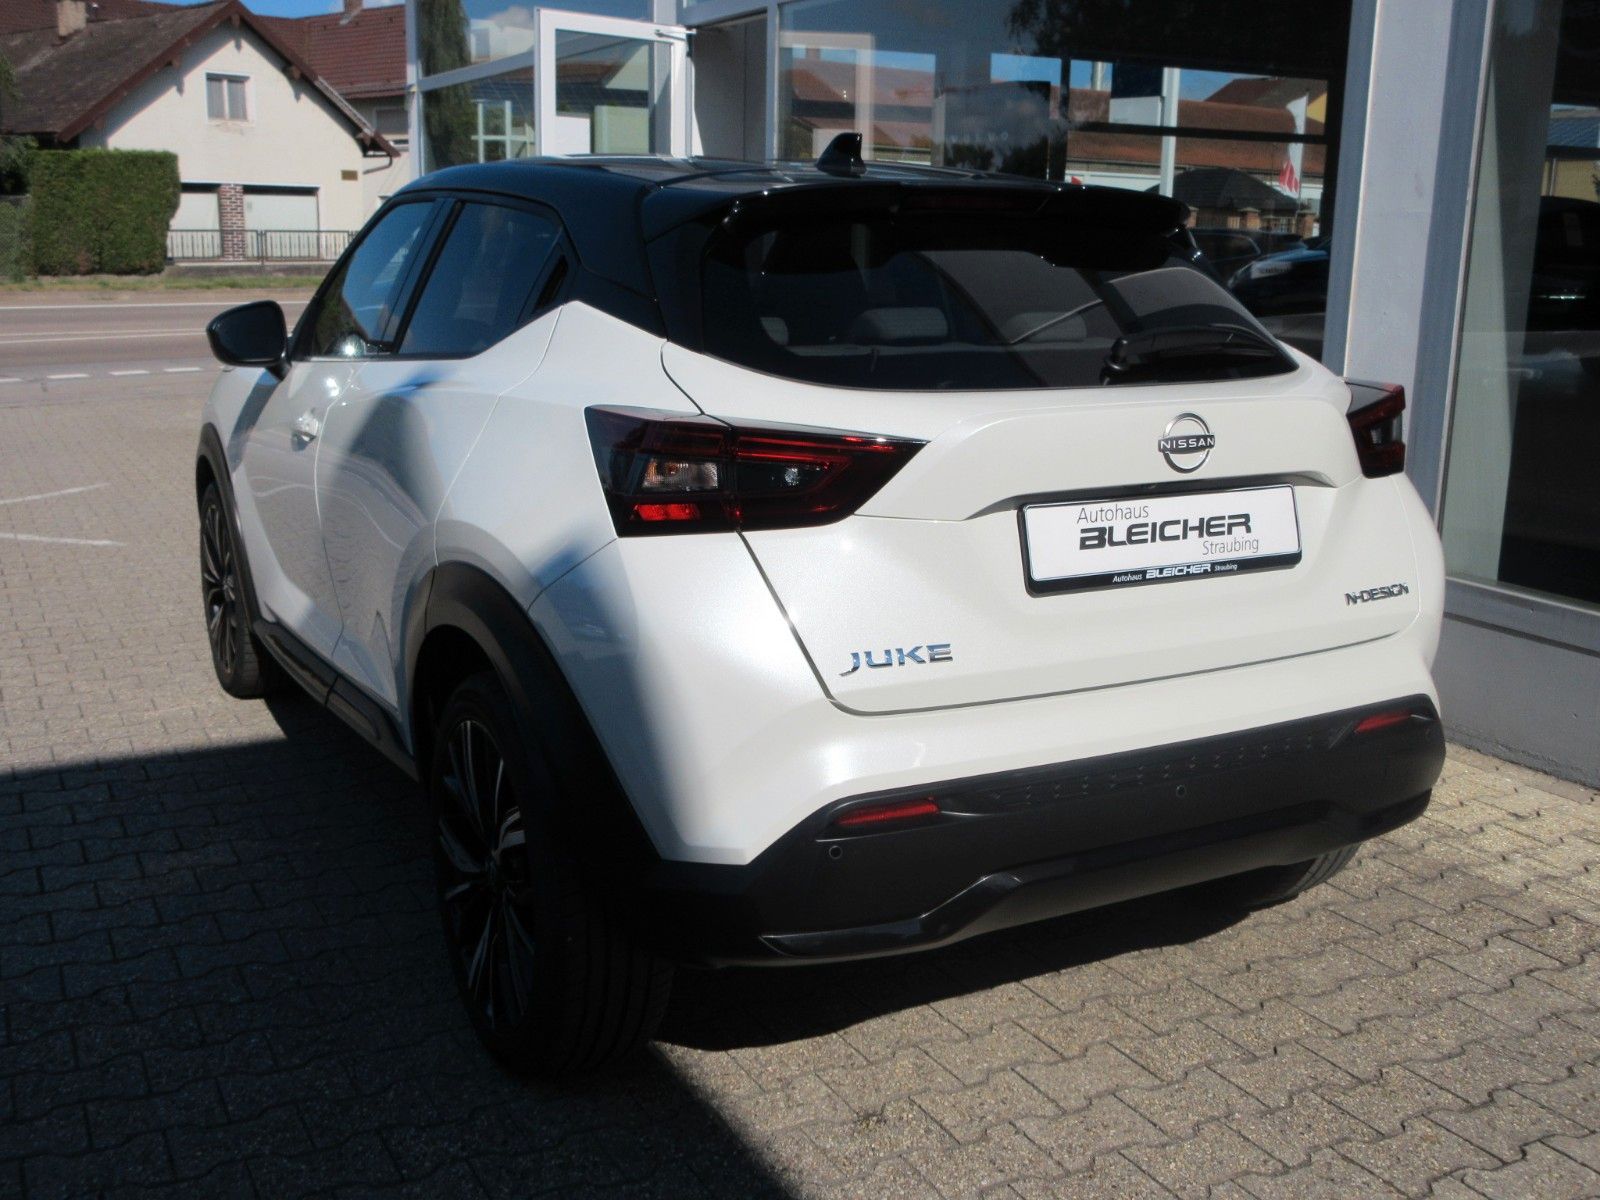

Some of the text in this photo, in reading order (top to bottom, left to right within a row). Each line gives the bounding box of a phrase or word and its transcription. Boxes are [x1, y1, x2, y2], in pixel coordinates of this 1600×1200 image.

[1160, 437, 1214, 449] NISSAN
[1077, 504, 1149, 524] Autohaus
[1079, 513, 1251, 550] BLEICHER
[1202, 537, 1259, 556] Straubing
[1112, 563, 1238, 583] Autohaus BLEICHER Straubing
[1344, 583, 1409, 605] N-DESIGN
[838, 643, 953, 677] JUKE
